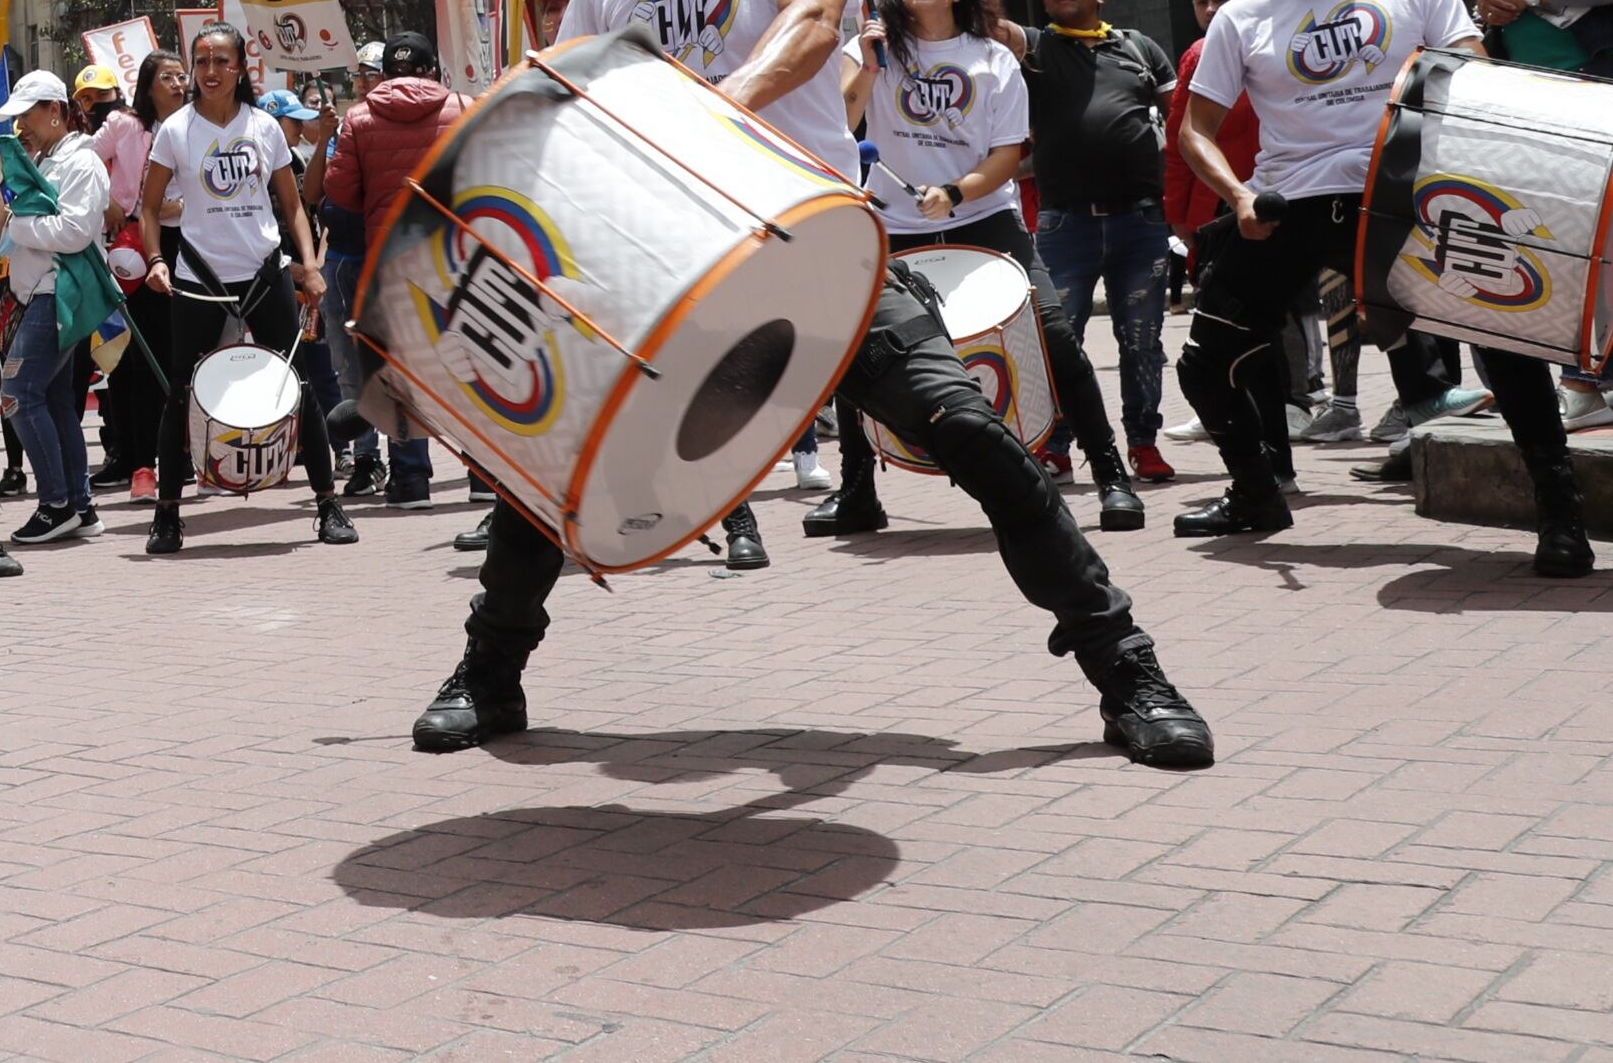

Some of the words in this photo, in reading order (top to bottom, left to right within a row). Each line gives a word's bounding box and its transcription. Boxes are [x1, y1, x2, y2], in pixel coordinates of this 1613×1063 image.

[1310, 17, 1362, 65] CUT
[914, 77, 954, 115] CUT
[217, 151, 250, 185] CUT
[1436, 209, 1517, 285] CUT
[448, 243, 553, 389] CUT
[230, 437, 286, 479] CUT
